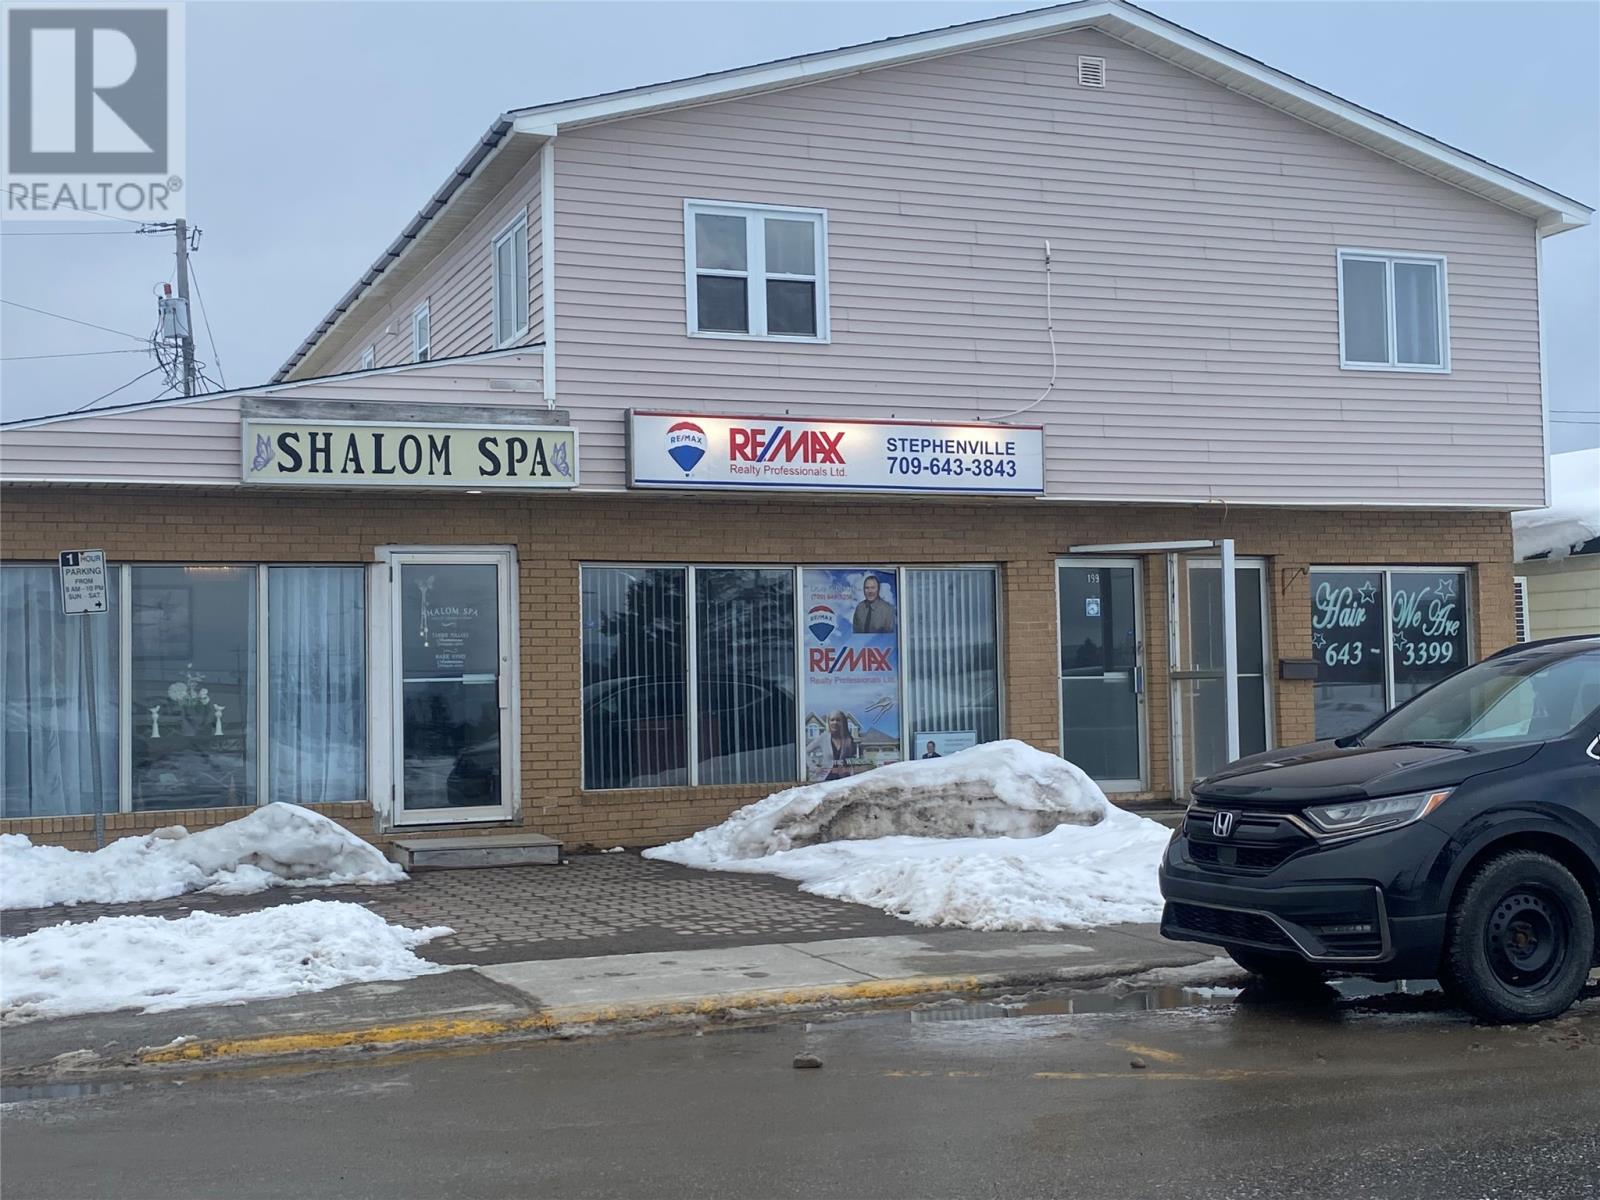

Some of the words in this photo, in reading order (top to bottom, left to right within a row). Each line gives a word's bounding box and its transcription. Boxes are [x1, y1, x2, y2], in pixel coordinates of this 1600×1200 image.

[670, 434, 703, 444] RE/MAX
[729, 425, 846, 464] RE/MAX
[886, 437, 1016, 456] STEPHENVILLE
[277, 431, 452, 475] SHALOM
[478, 436, 552, 477] SPA
[729, 464, 761, 476] Realty
[763, 465, 827, 476] Professionals
[830, 467, 848, 477] Ltd.
[886, 456, 1017, 477] 709-643-3843
[66, 553, 74, 565] 1
[81, 554, 101, 563] HOUR
[65, 567, 102, 575] PARKING
[1087, 573, 1100, 584] 199
[463, 607, 479, 616] SPA
[1312, 582, 1367, 629] Hair
[1392, 586, 1430, 629] We
[1422, 599, 1460, 636] Are
[809, 646, 893, 674] RE/MAX
[1325, 641, 1362, 666] 643
[1402, 641, 1453, 666] 3399
